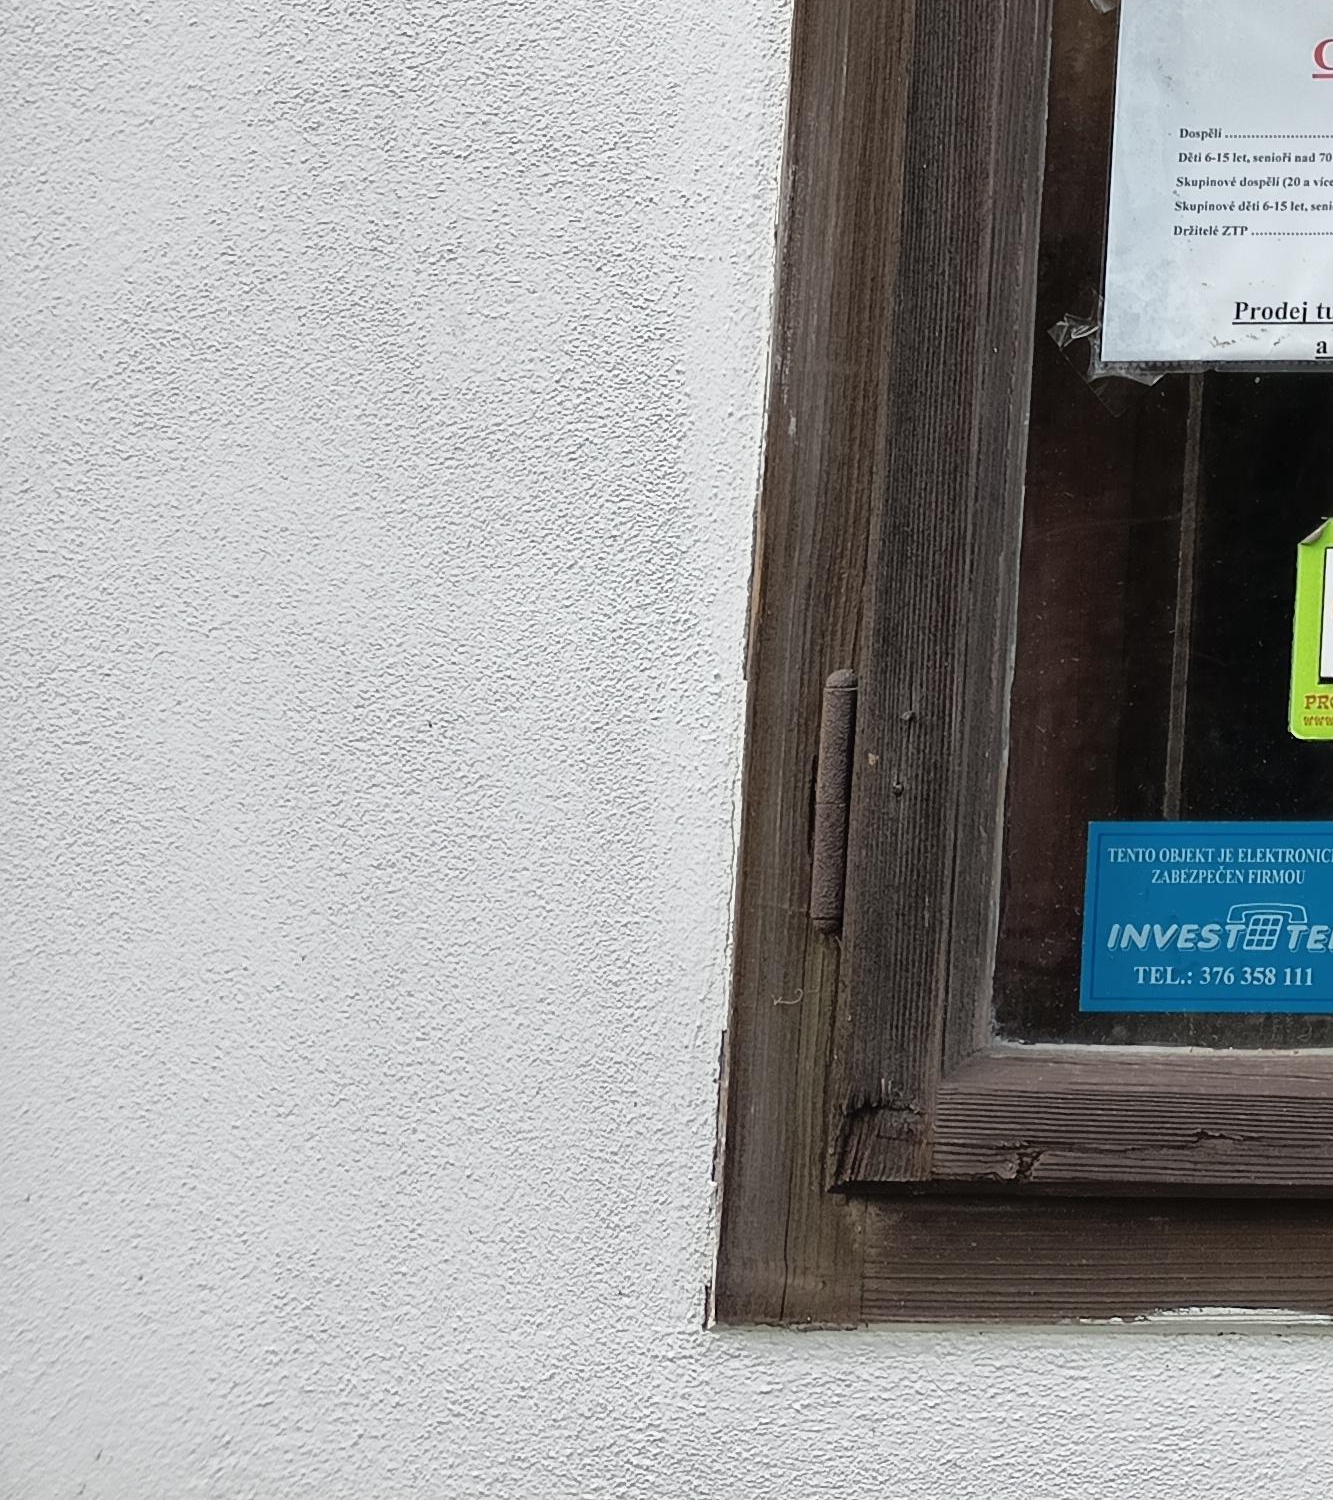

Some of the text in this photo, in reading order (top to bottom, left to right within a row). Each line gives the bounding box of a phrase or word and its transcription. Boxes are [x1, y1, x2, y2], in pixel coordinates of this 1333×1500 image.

[1180, 128, 1222, 141] Dospělí
[1179, 152, 1201, 162] Děti
[1205, 153, 1229, 162] 6-15
[1233, 152, 1250, 163] let,
[1253, 152, 1291, 162] senioři
[1295, 153, 1315, 162] nad
[1319, 153, 1332, 162] 70
[1176, 177, 1236, 191] Skupinové
[1240, 177, 1280, 189] dospělí
[1283, 177, 1300, 188] (20
[1174, 201, 1235, 214] Skupinové
[1238, 201, 1259, 211] děti
[1263, 201, 1287, 211] 6-15
[1291, 201, 1308, 212] let,
[1174, 225, 1219, 236] Držitelé
[1222, 226, 1248, 236] ZTP
[1234, 301, 1308, 322] Prodej
[1108, 848, 1156, 863] TENTO
[1159, 848, 1216, 864] OBJEKT
[1218, 848, 1235, 863] JE
[1151, 866, 1305, 884] ZABEZPEČEN FIRMOU
[1134, 966, 1313, 986] TEL.: 376 358 111
